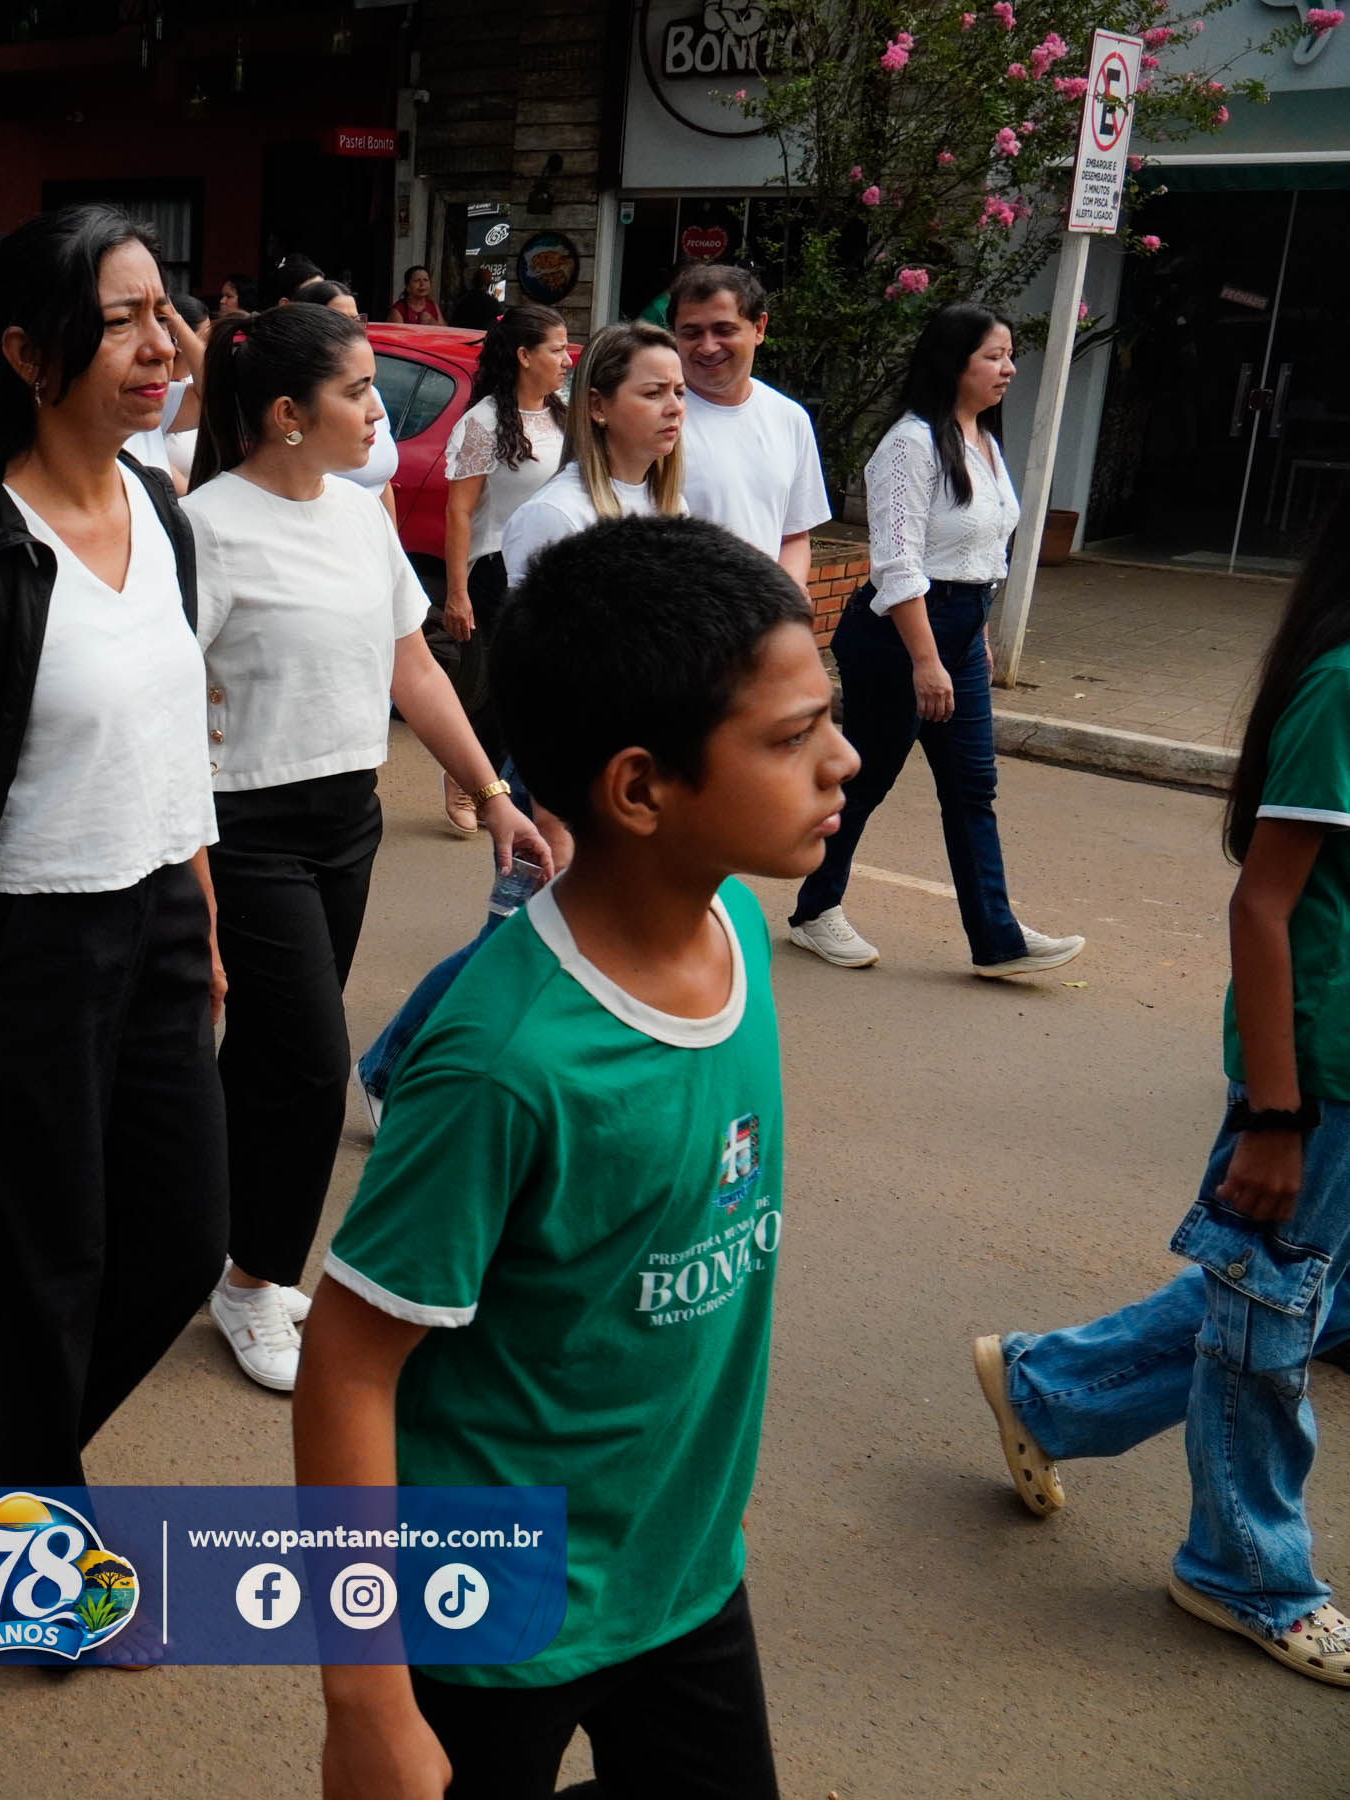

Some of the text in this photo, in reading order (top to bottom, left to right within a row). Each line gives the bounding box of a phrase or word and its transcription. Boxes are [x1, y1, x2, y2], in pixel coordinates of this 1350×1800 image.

[339, 134, 394, 151] Pastel Bonito
[1085, 157, 1117, 171] EMBARQUE E
[1081, 170, 1118, 184] DESEMBARQUE
[1089, 184, 1110, 196] MINUTOS
[1082, 196, 1108, 208] COM PISCA
[1075, 208, 1114, 221] ALERTA LIGADO
[686, 239, 722, 248] FECHADO
[651, 1307, 695, 1326] MATO
